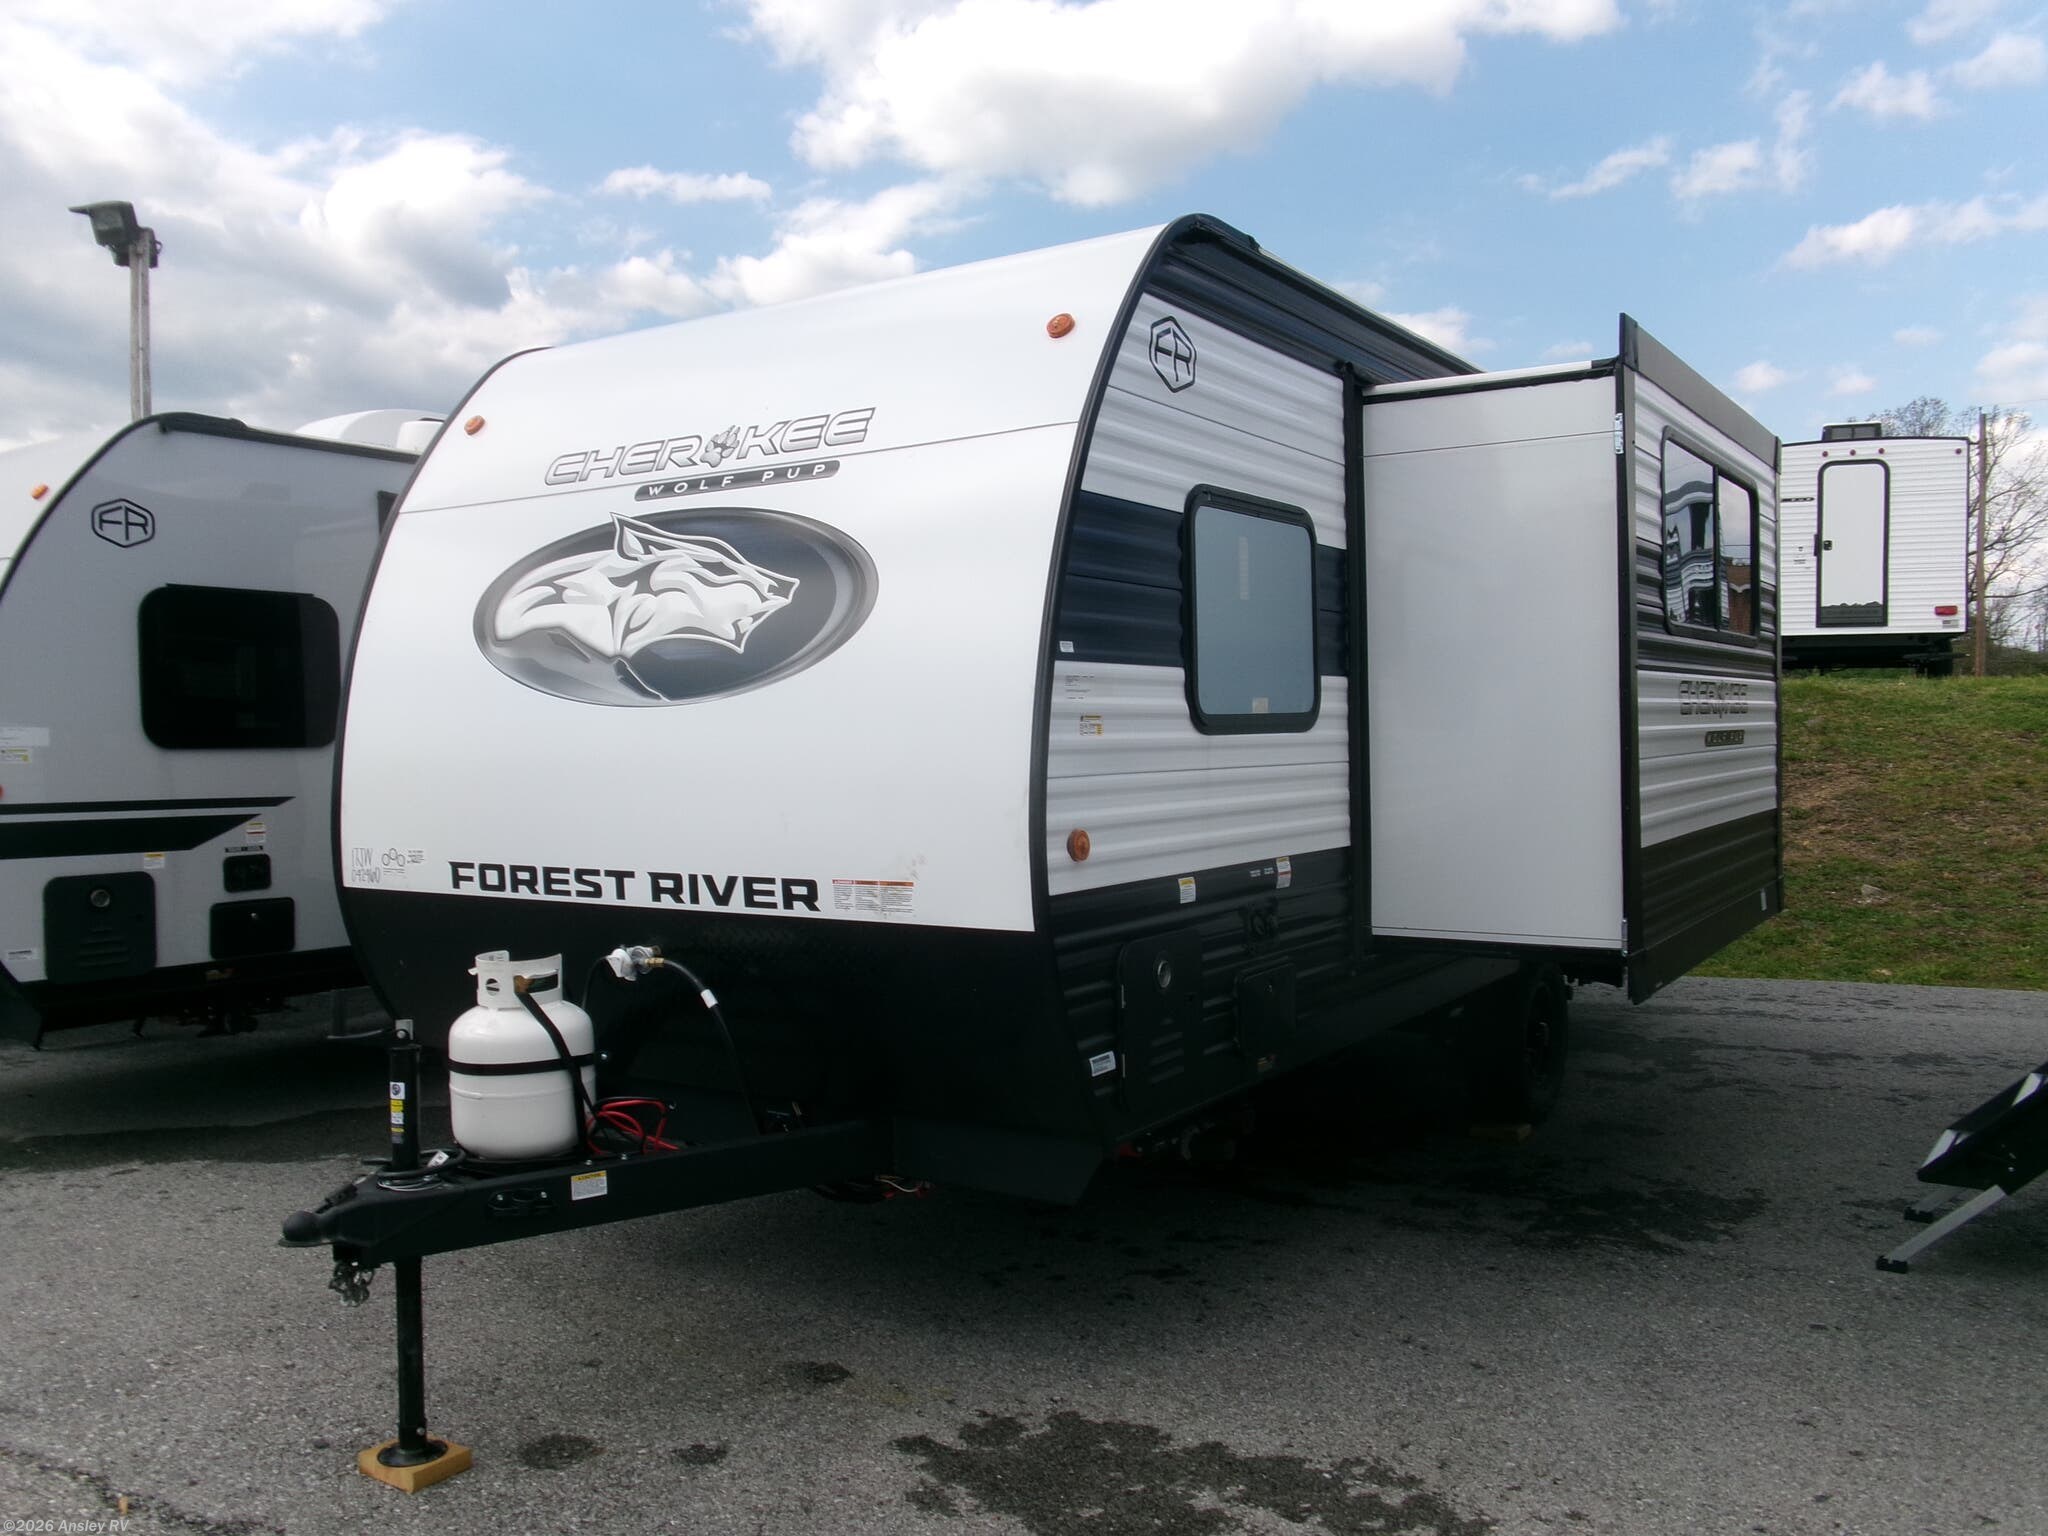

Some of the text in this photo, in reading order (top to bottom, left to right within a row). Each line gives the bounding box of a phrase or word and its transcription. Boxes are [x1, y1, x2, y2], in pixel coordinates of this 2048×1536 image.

[648, 463, 828, 497] WOLF PUP
[448, 861, 637, 901] FOREST
[647, 871, 822, 912] RIVER
